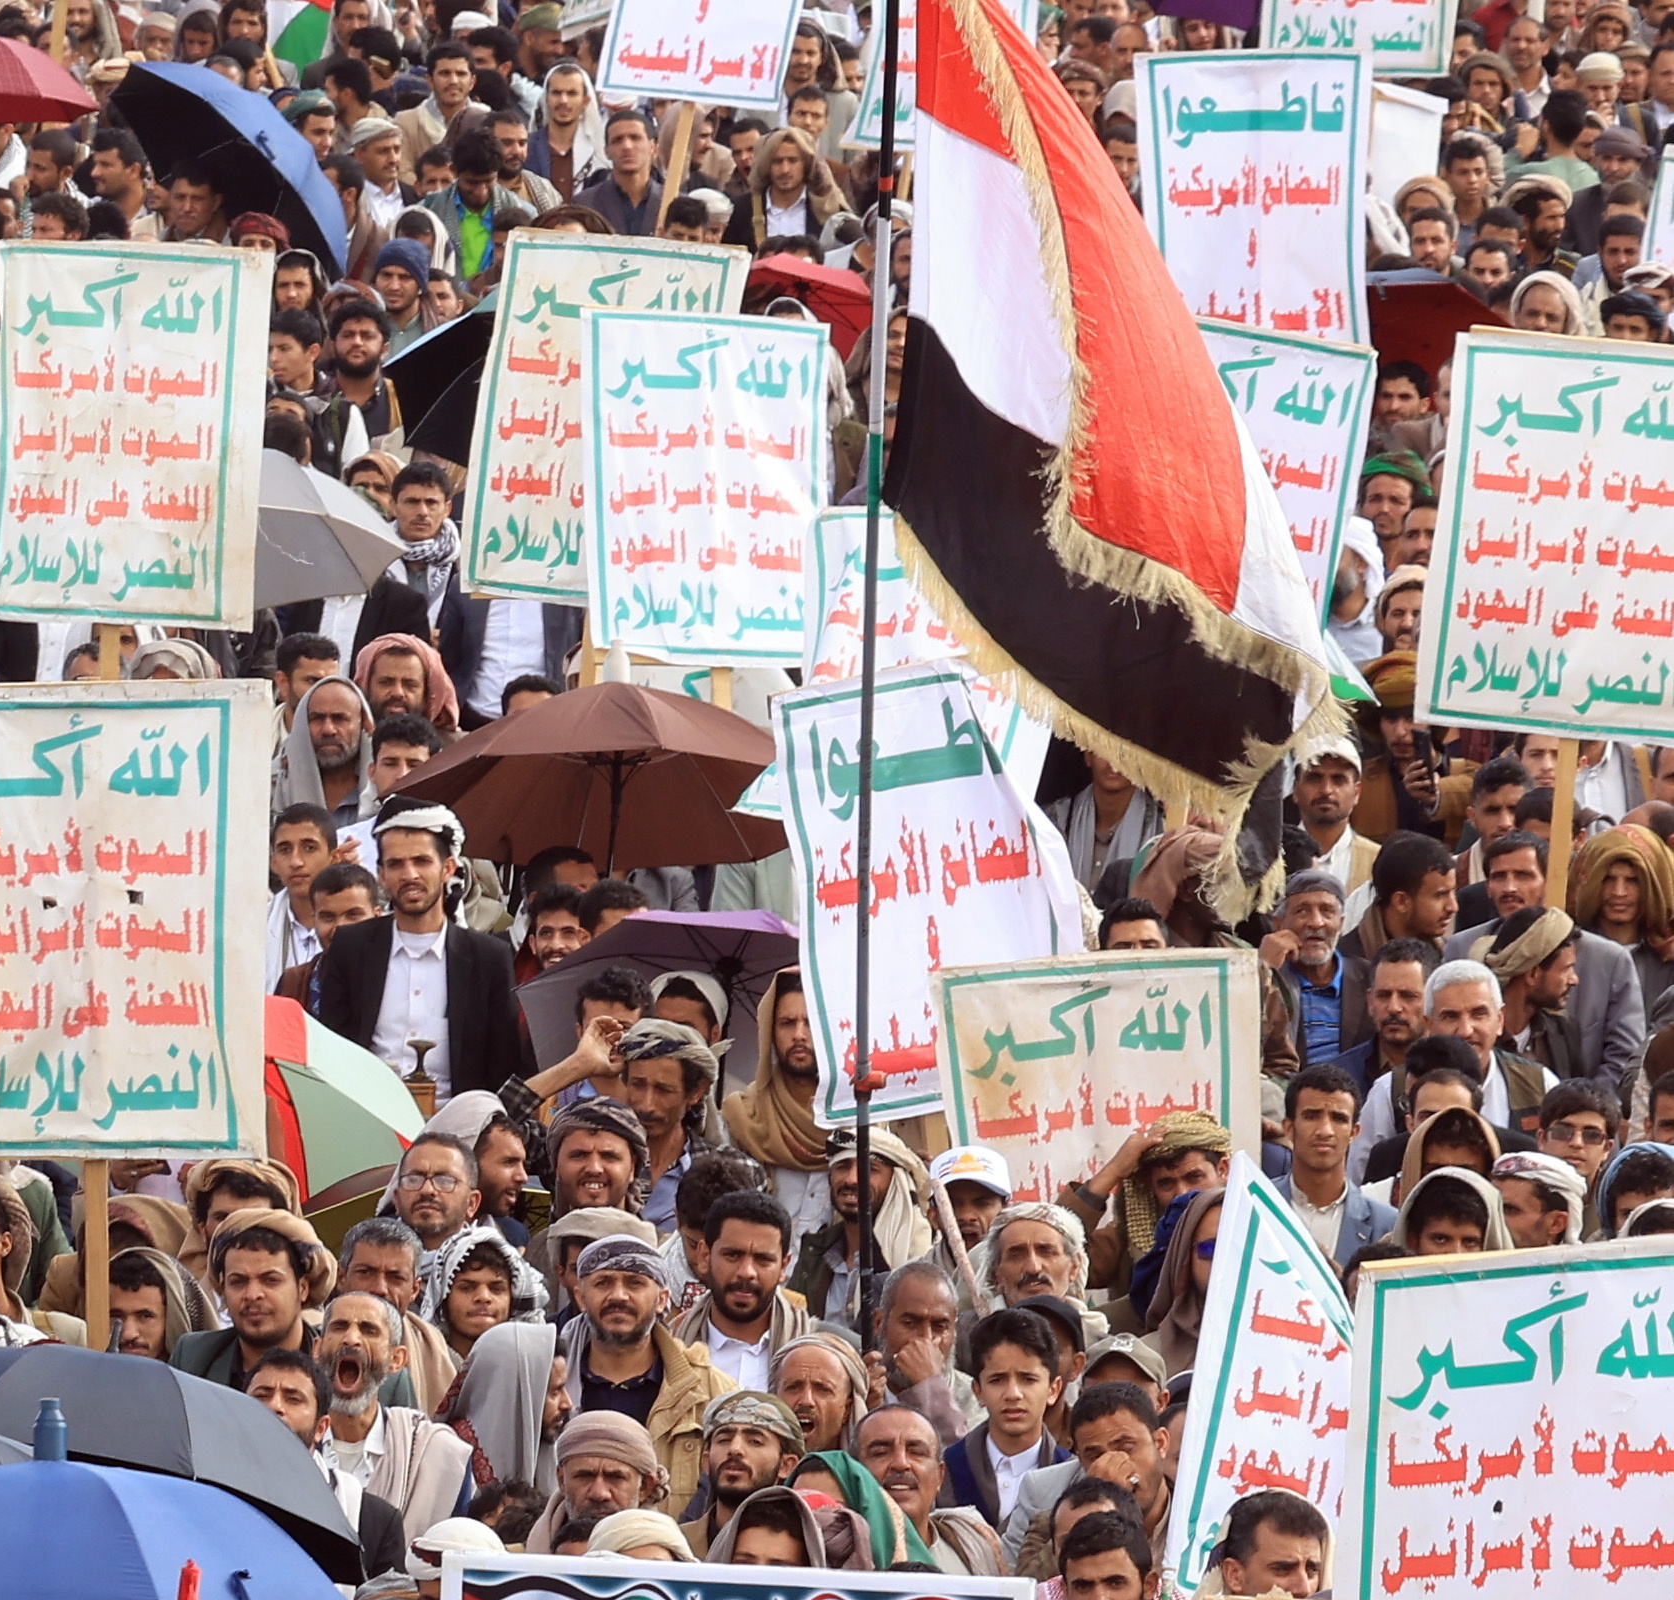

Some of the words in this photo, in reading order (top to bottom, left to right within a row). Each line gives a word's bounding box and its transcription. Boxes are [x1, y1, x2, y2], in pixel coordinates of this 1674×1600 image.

[619, 41, 779, 84] الإسرائيلية
[1372, 16, 1435, 53] النصر
[1163, 83, 1345, 149] قاطعوا
[1169, 164, 1260, 217] الأمريكية
[1261, 164, 1342, 216] البضائع
[16, 269, 138, 343] أكبر
[142, 282, 221, 333] الله
[13, 350, 115, 398] لأمريكا
[123, 363, 218, 404] الموت
[607, 331, 729, 406] أكبر
[1479, 372, 1619, 446] أكبر
[9, 480, 77, 523] اليهود
[86, 482, 130, 526] على
[142, 481, 214, 526] اللعنة
[1473, 452, 1593, 505] لأمريكا
[1, 536, 104, 603] للإسلام
[112, 540, 206, 601] النصر
[611, 531, 686, 572] اليهود
[699, 542, 736, 572] على
[614, 583, 724, 655] للإسلام
[1448, 644, 1567, 711] للإسلام
[109, 728, 210, 796] الله
[968, 980, 1113, 1086] أكبر
[1121, 991, 1211, 1050] الله
[94, 1045, 217, 1130] النصر
[969, 1072, 1099, 1148] لأمريكا
[1389, 1282, 1588, 1420] أكبر
[1388, 1405, 1556, 1496] لأمريكا
